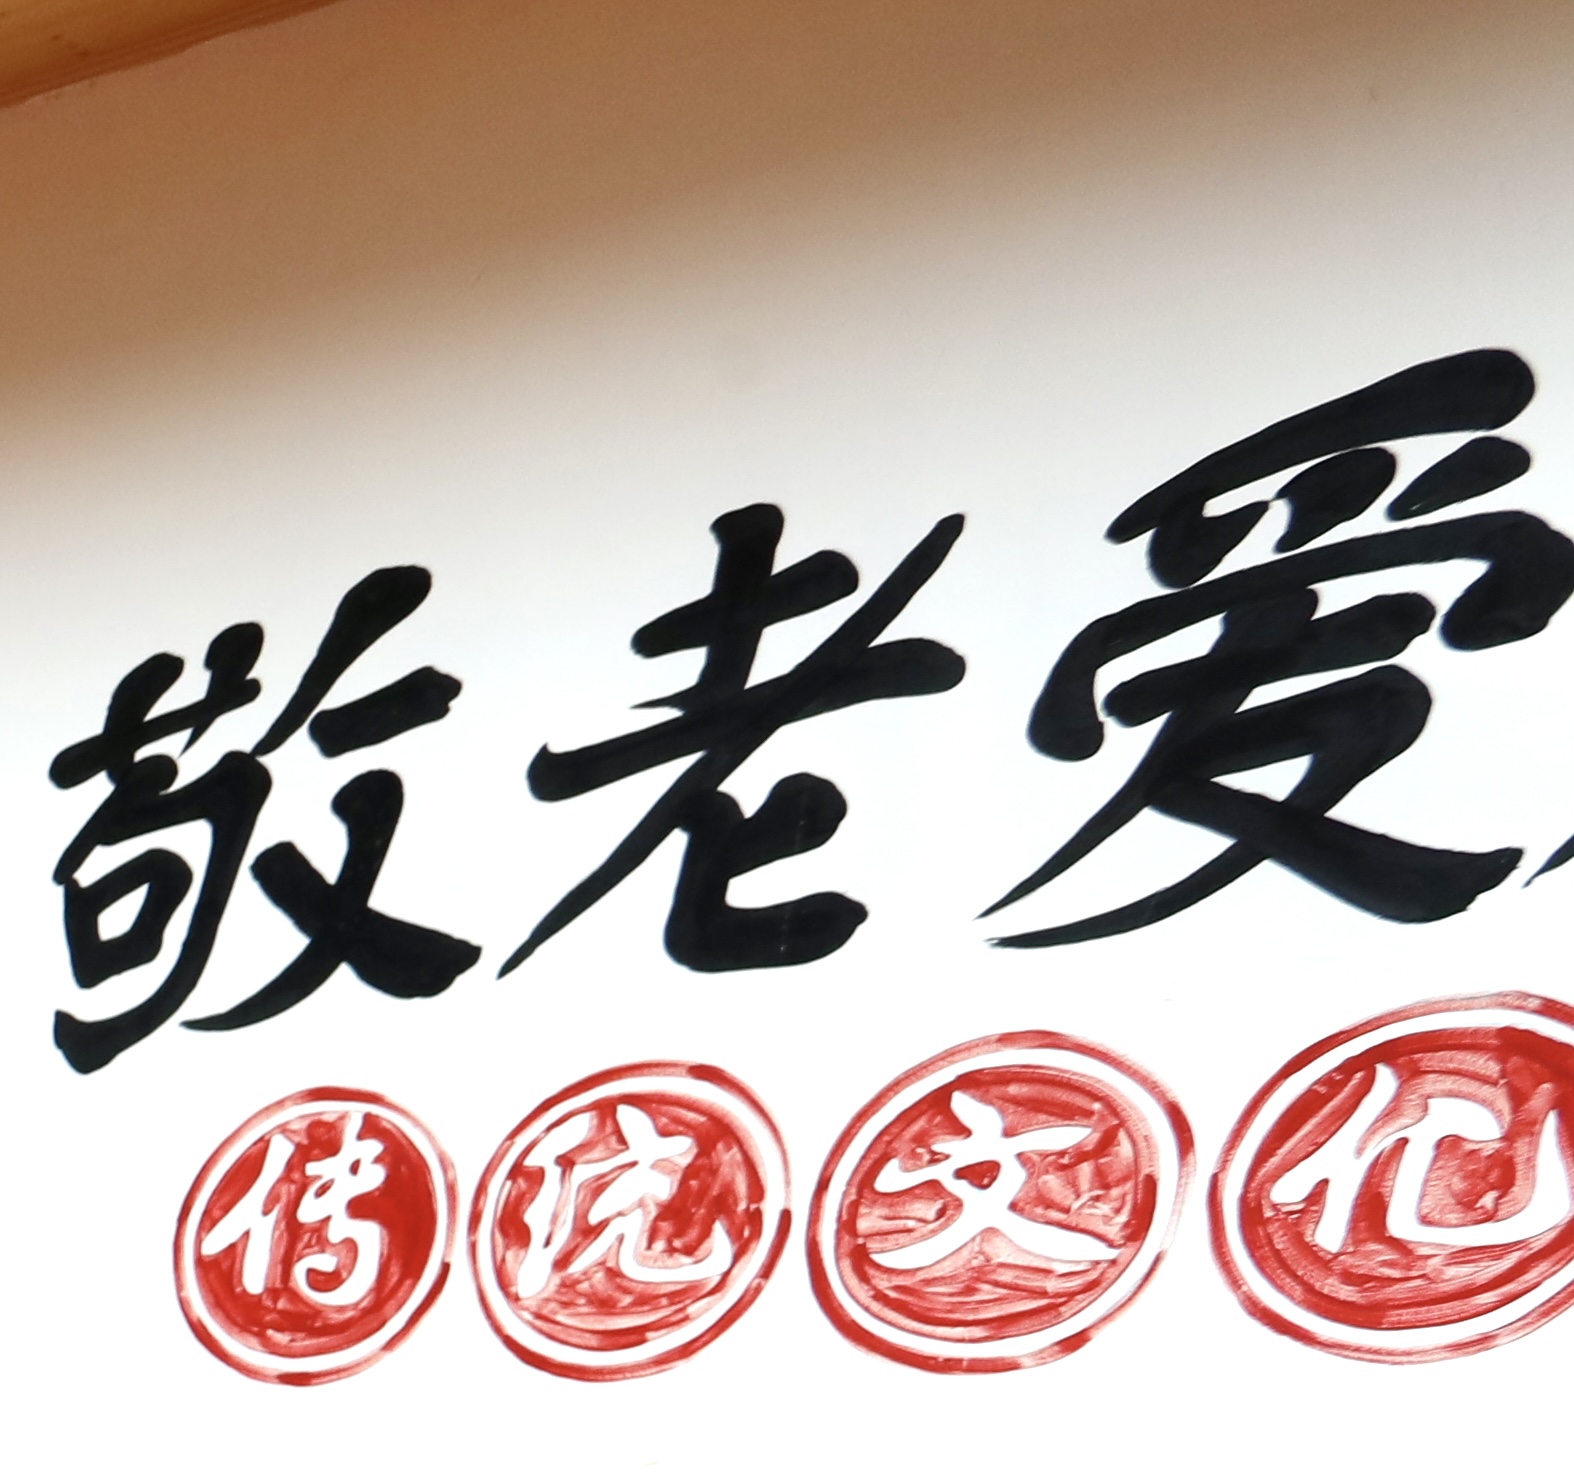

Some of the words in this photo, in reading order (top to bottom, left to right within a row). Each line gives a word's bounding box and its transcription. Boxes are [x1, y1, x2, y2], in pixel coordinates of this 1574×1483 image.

[52, 346, 1574, 1075] 敬老爱
[198, 1062, 1574, 1310] 传统文化
